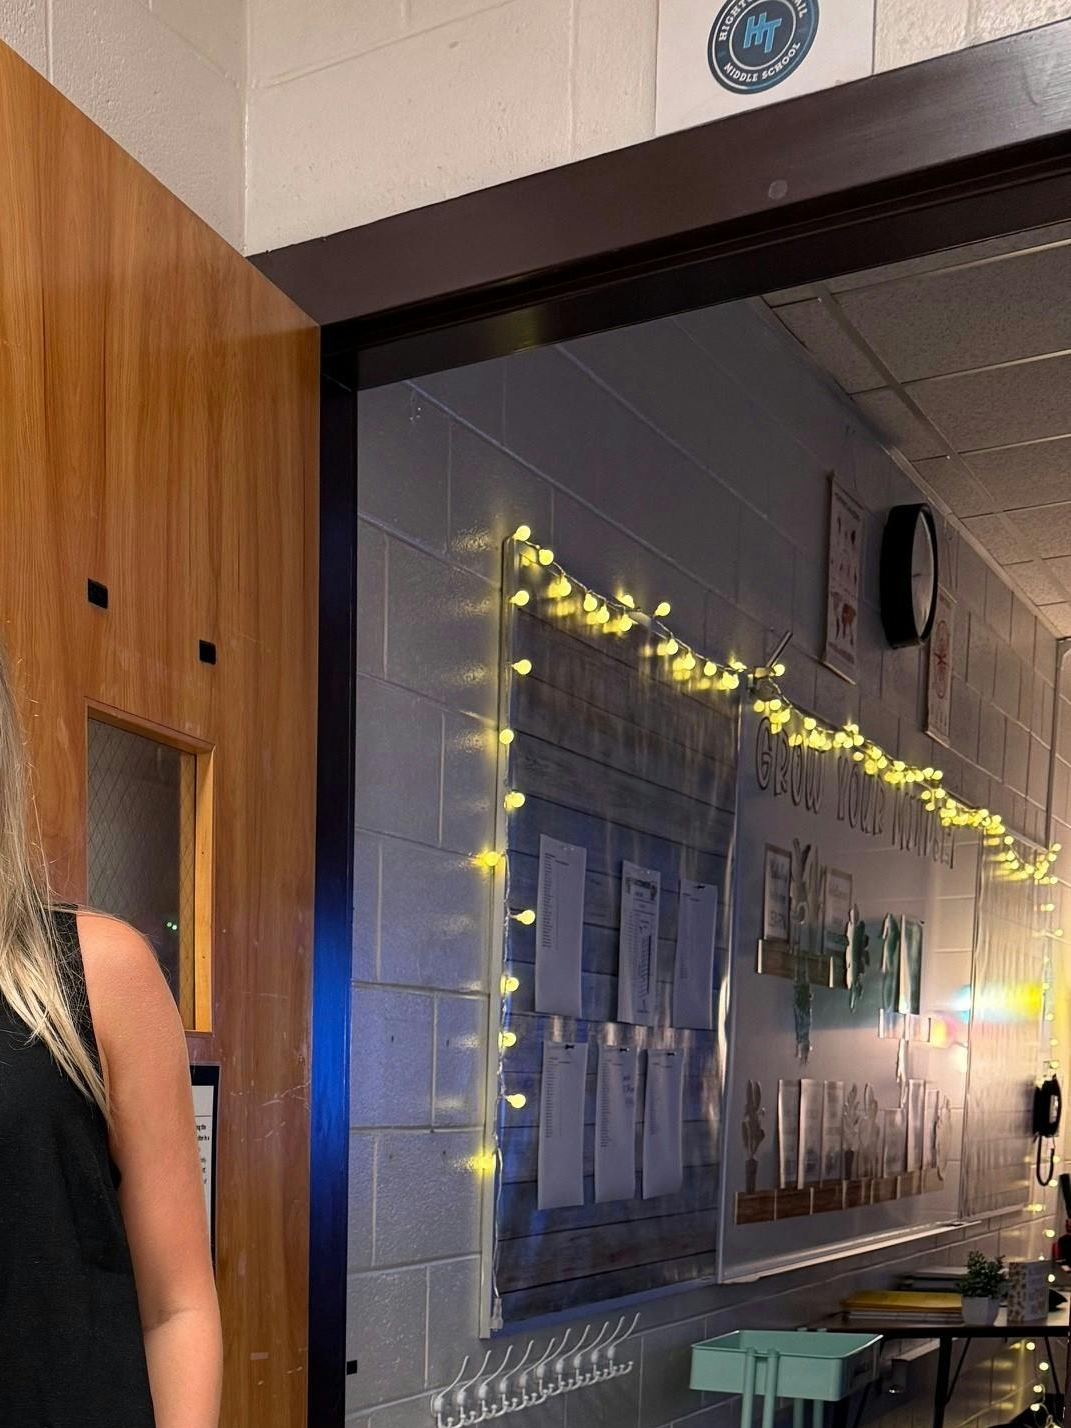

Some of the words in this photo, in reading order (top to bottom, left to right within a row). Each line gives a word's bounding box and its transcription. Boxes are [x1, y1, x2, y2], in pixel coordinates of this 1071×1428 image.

[719, 0, 753, 41] HIGHT
[743, 12, 783, 54] HT
[724, 62, 759, 82] MIDDLE
[761, 42, 801, 80] SCHOOL
